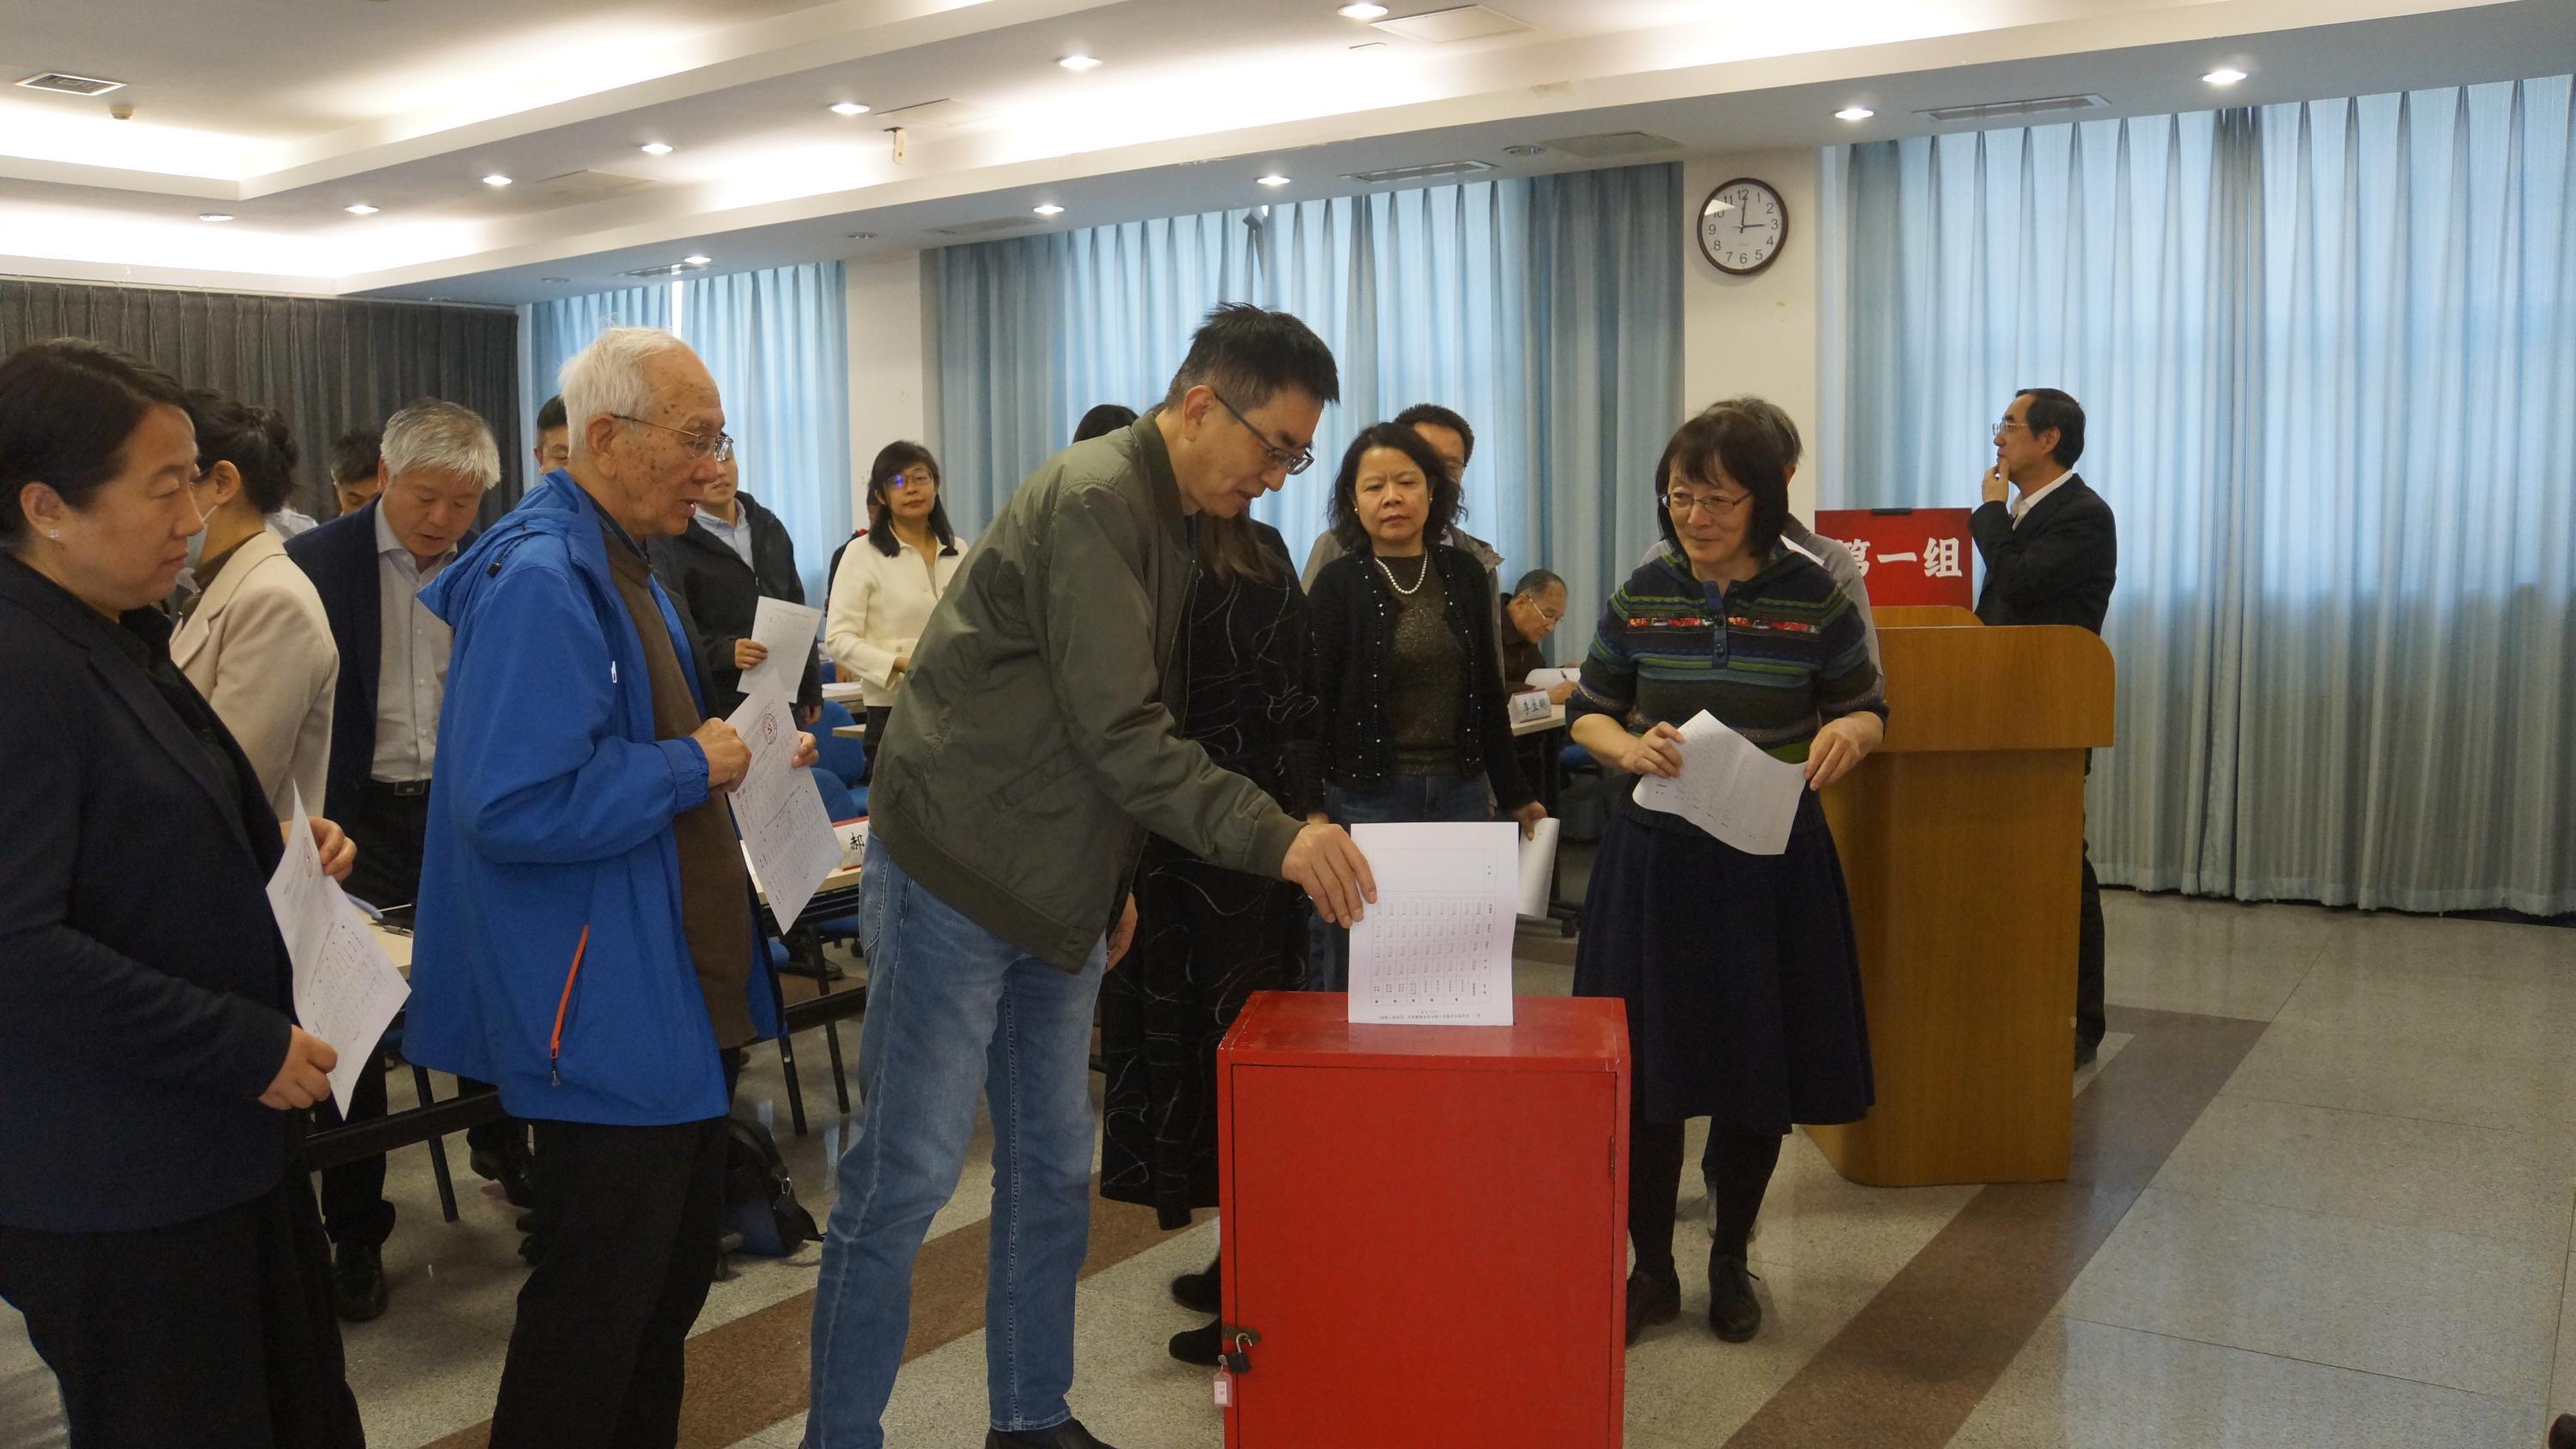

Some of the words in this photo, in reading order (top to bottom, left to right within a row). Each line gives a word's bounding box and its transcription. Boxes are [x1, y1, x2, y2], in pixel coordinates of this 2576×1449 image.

[1737, 189, 1749, 200] 12
[1757, 192, 1760, 203] 1
[1766, 203, 1774, 214] 2
[1709, 224, 1716, 234] 9
[1771, 218, 1778, 230] 3
[1713, 239, 1721, 251] 8
[1766, 236, 1774, 246] 4
[1726, 252, 1733, 262] 7
[1740, 253, 1747, 264] 6
[1755, 250, 1763, 260] 5
[849, 832, 866, 856] 郝
